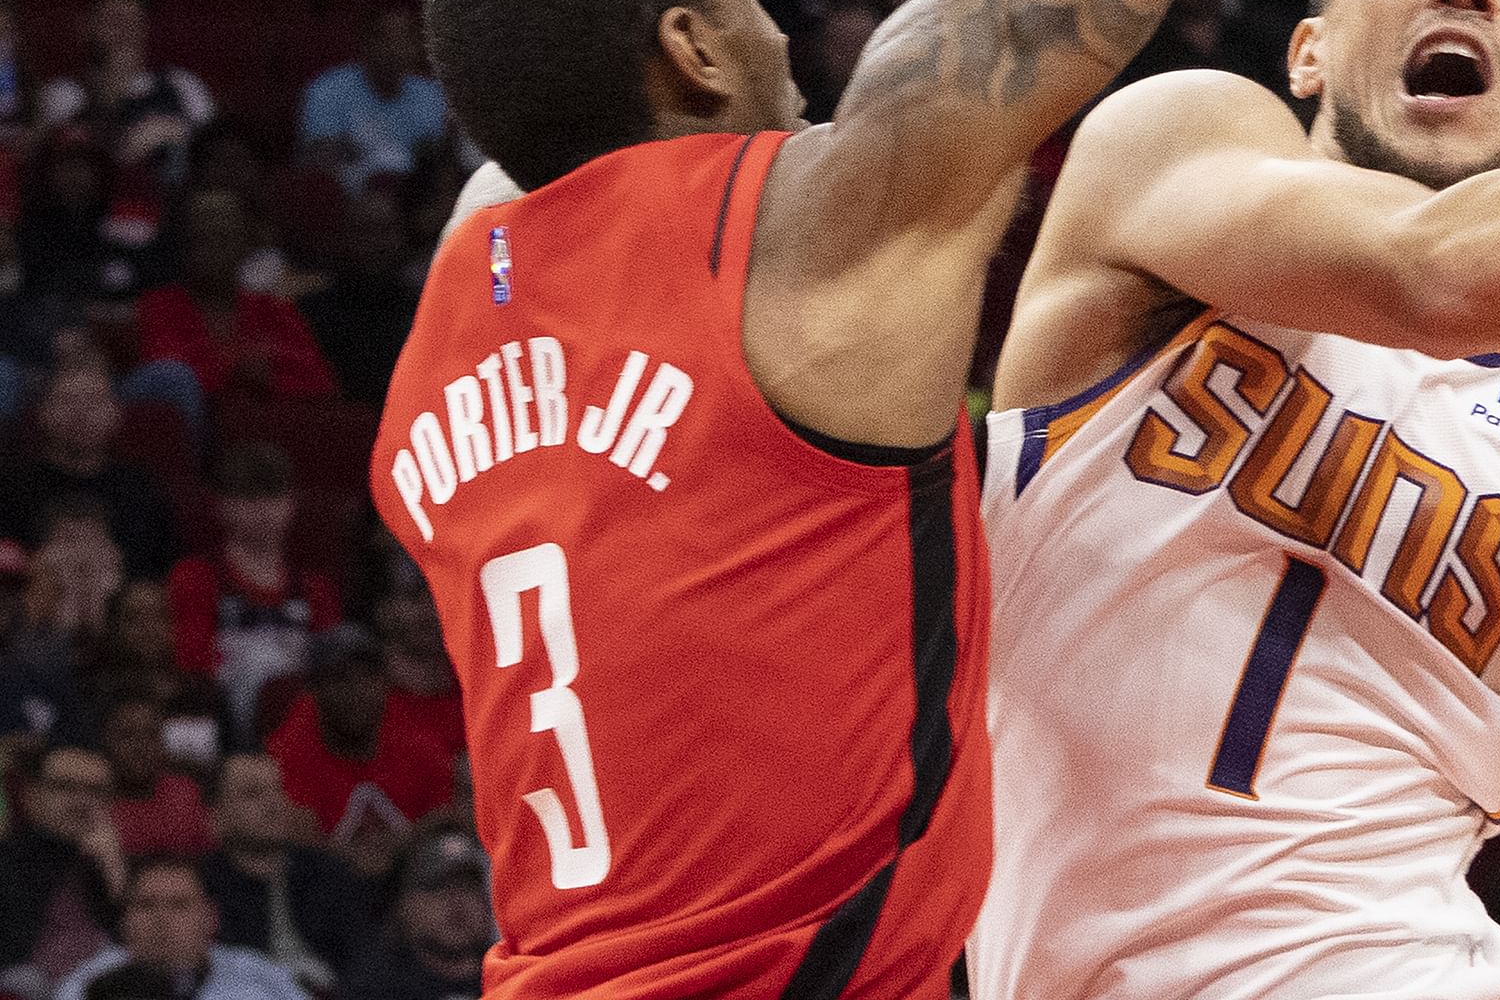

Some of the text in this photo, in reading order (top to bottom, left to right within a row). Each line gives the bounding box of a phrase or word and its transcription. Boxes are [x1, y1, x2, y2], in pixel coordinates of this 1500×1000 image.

[391, 336, 695, 542] PORTER JR.
[479, 541, 612, 890] 3
[1205, 550, 1328, 801] 1
